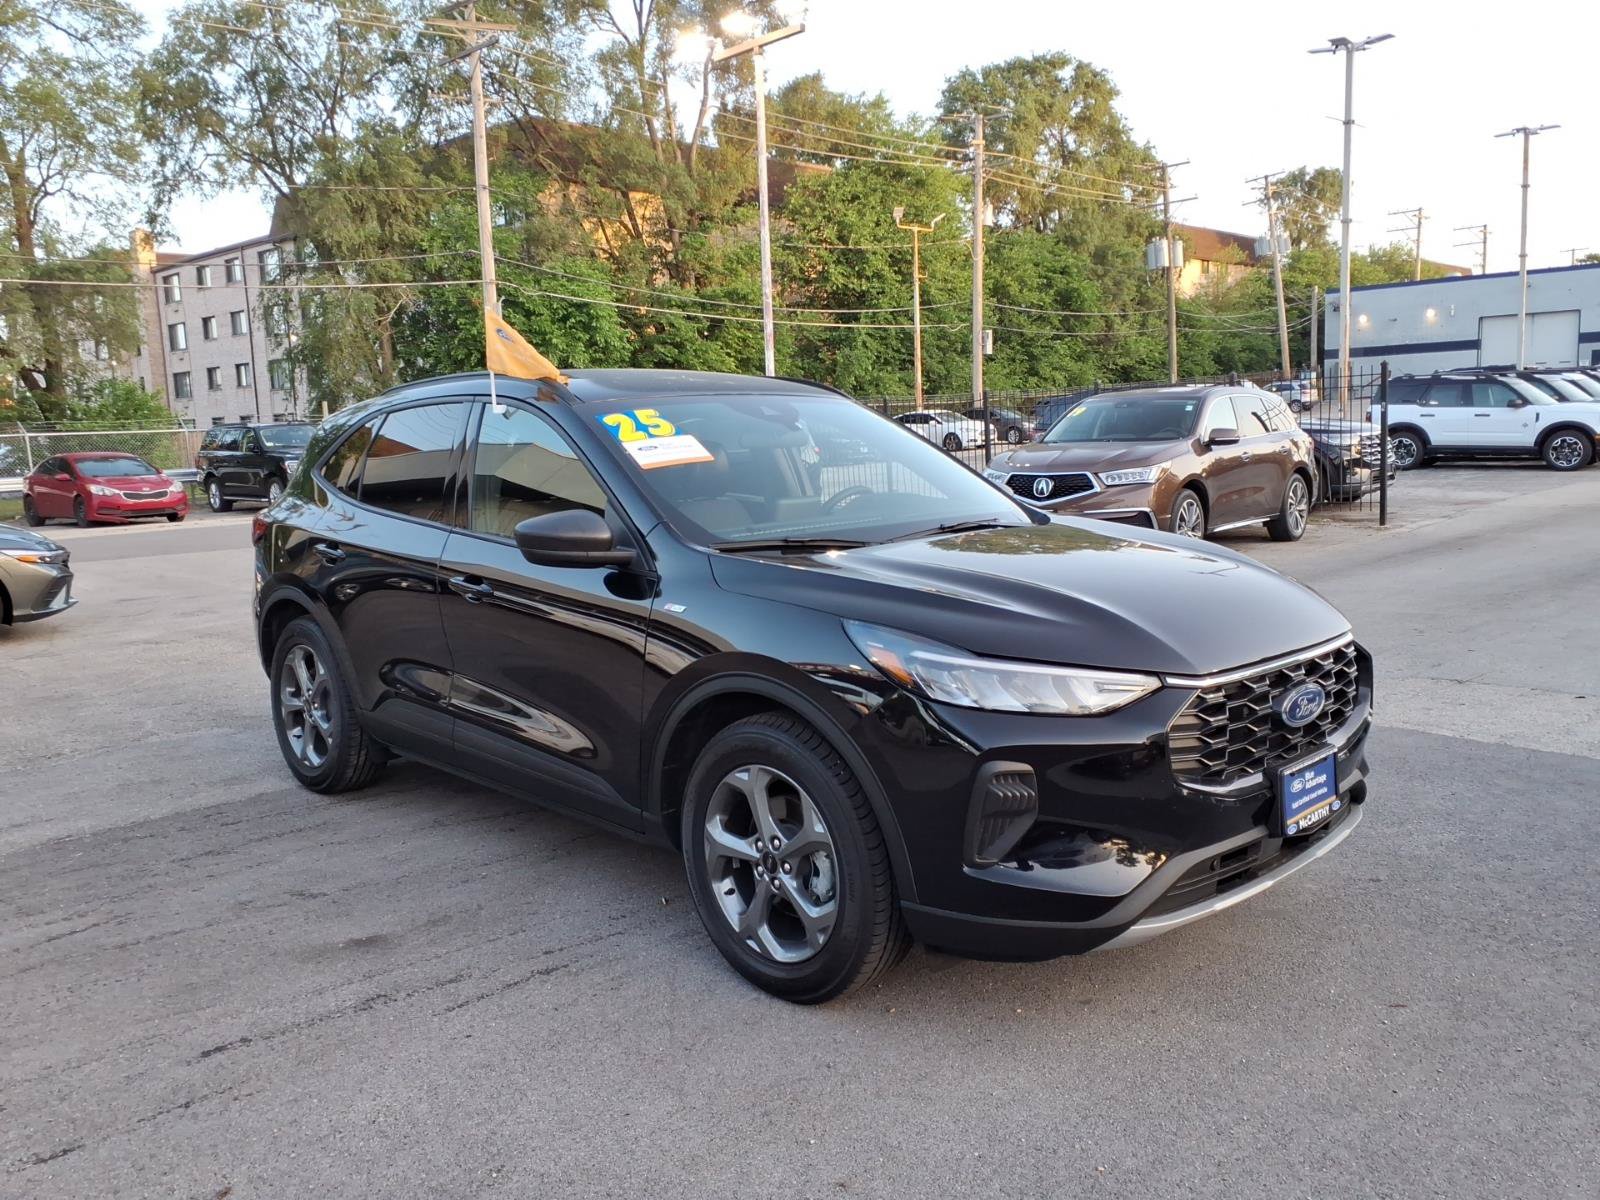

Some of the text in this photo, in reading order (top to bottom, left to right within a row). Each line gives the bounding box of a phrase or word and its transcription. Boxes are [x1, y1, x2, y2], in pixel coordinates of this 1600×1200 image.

[602, 408, 676, 443] 25
[1295, 692, 1320, 719] Ford
[1299, 805, 1330, 830] McCARTHY
